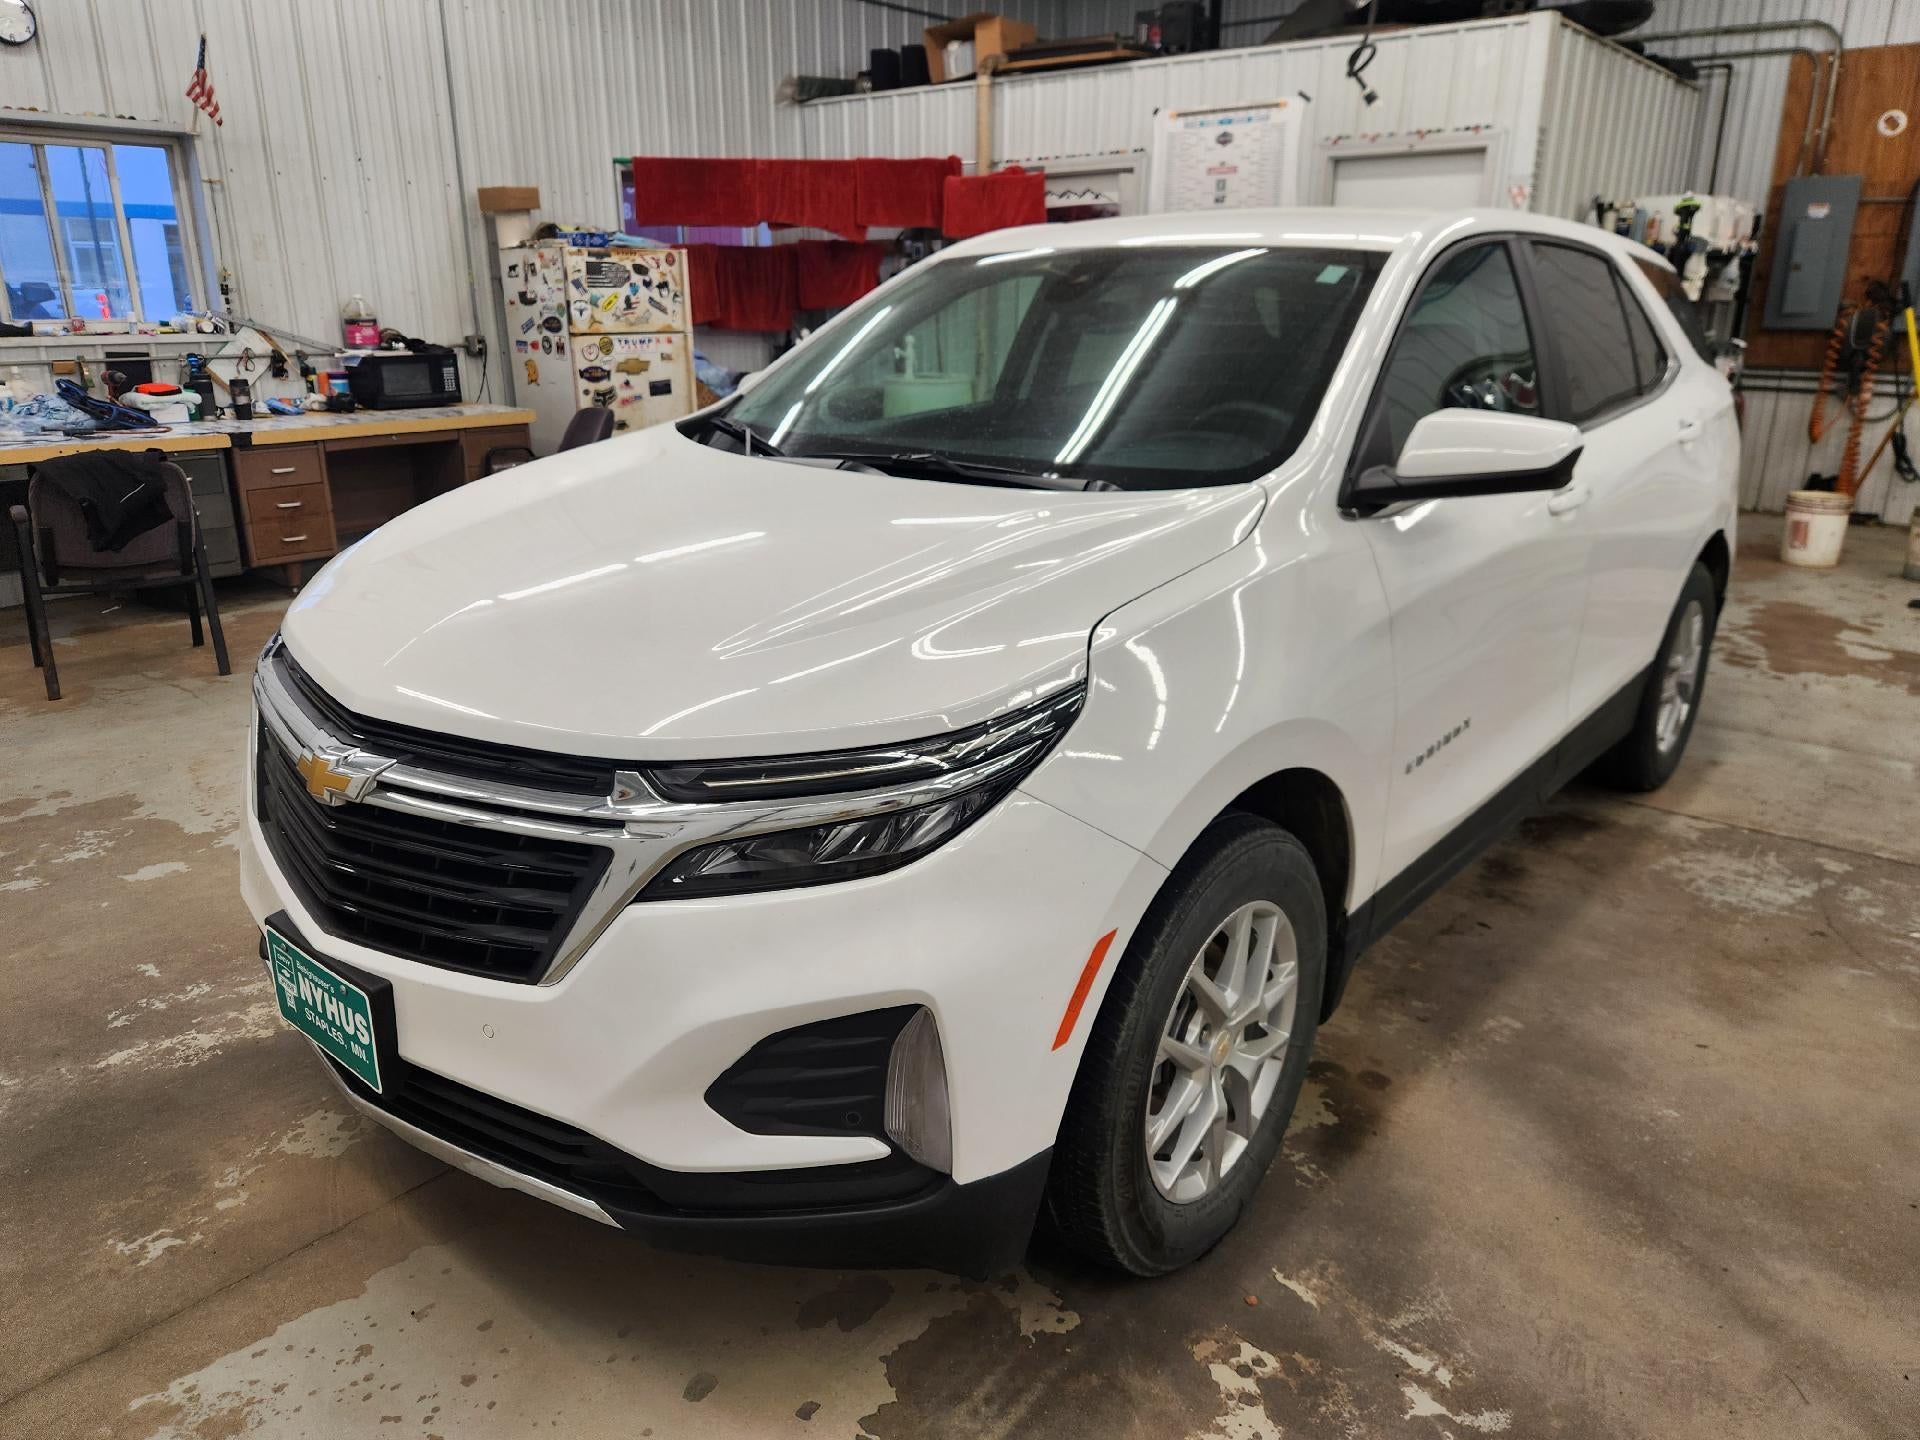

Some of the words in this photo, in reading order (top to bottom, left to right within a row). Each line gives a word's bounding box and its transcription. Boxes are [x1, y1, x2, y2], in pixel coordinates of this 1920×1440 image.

[617, 337, 652, 345] TRUMP
[298, 971, 370, 1045] NYHUS
[305, 1008, 348, 1050] STAPLES,
[351, 1041, 370, 1064] MN.
